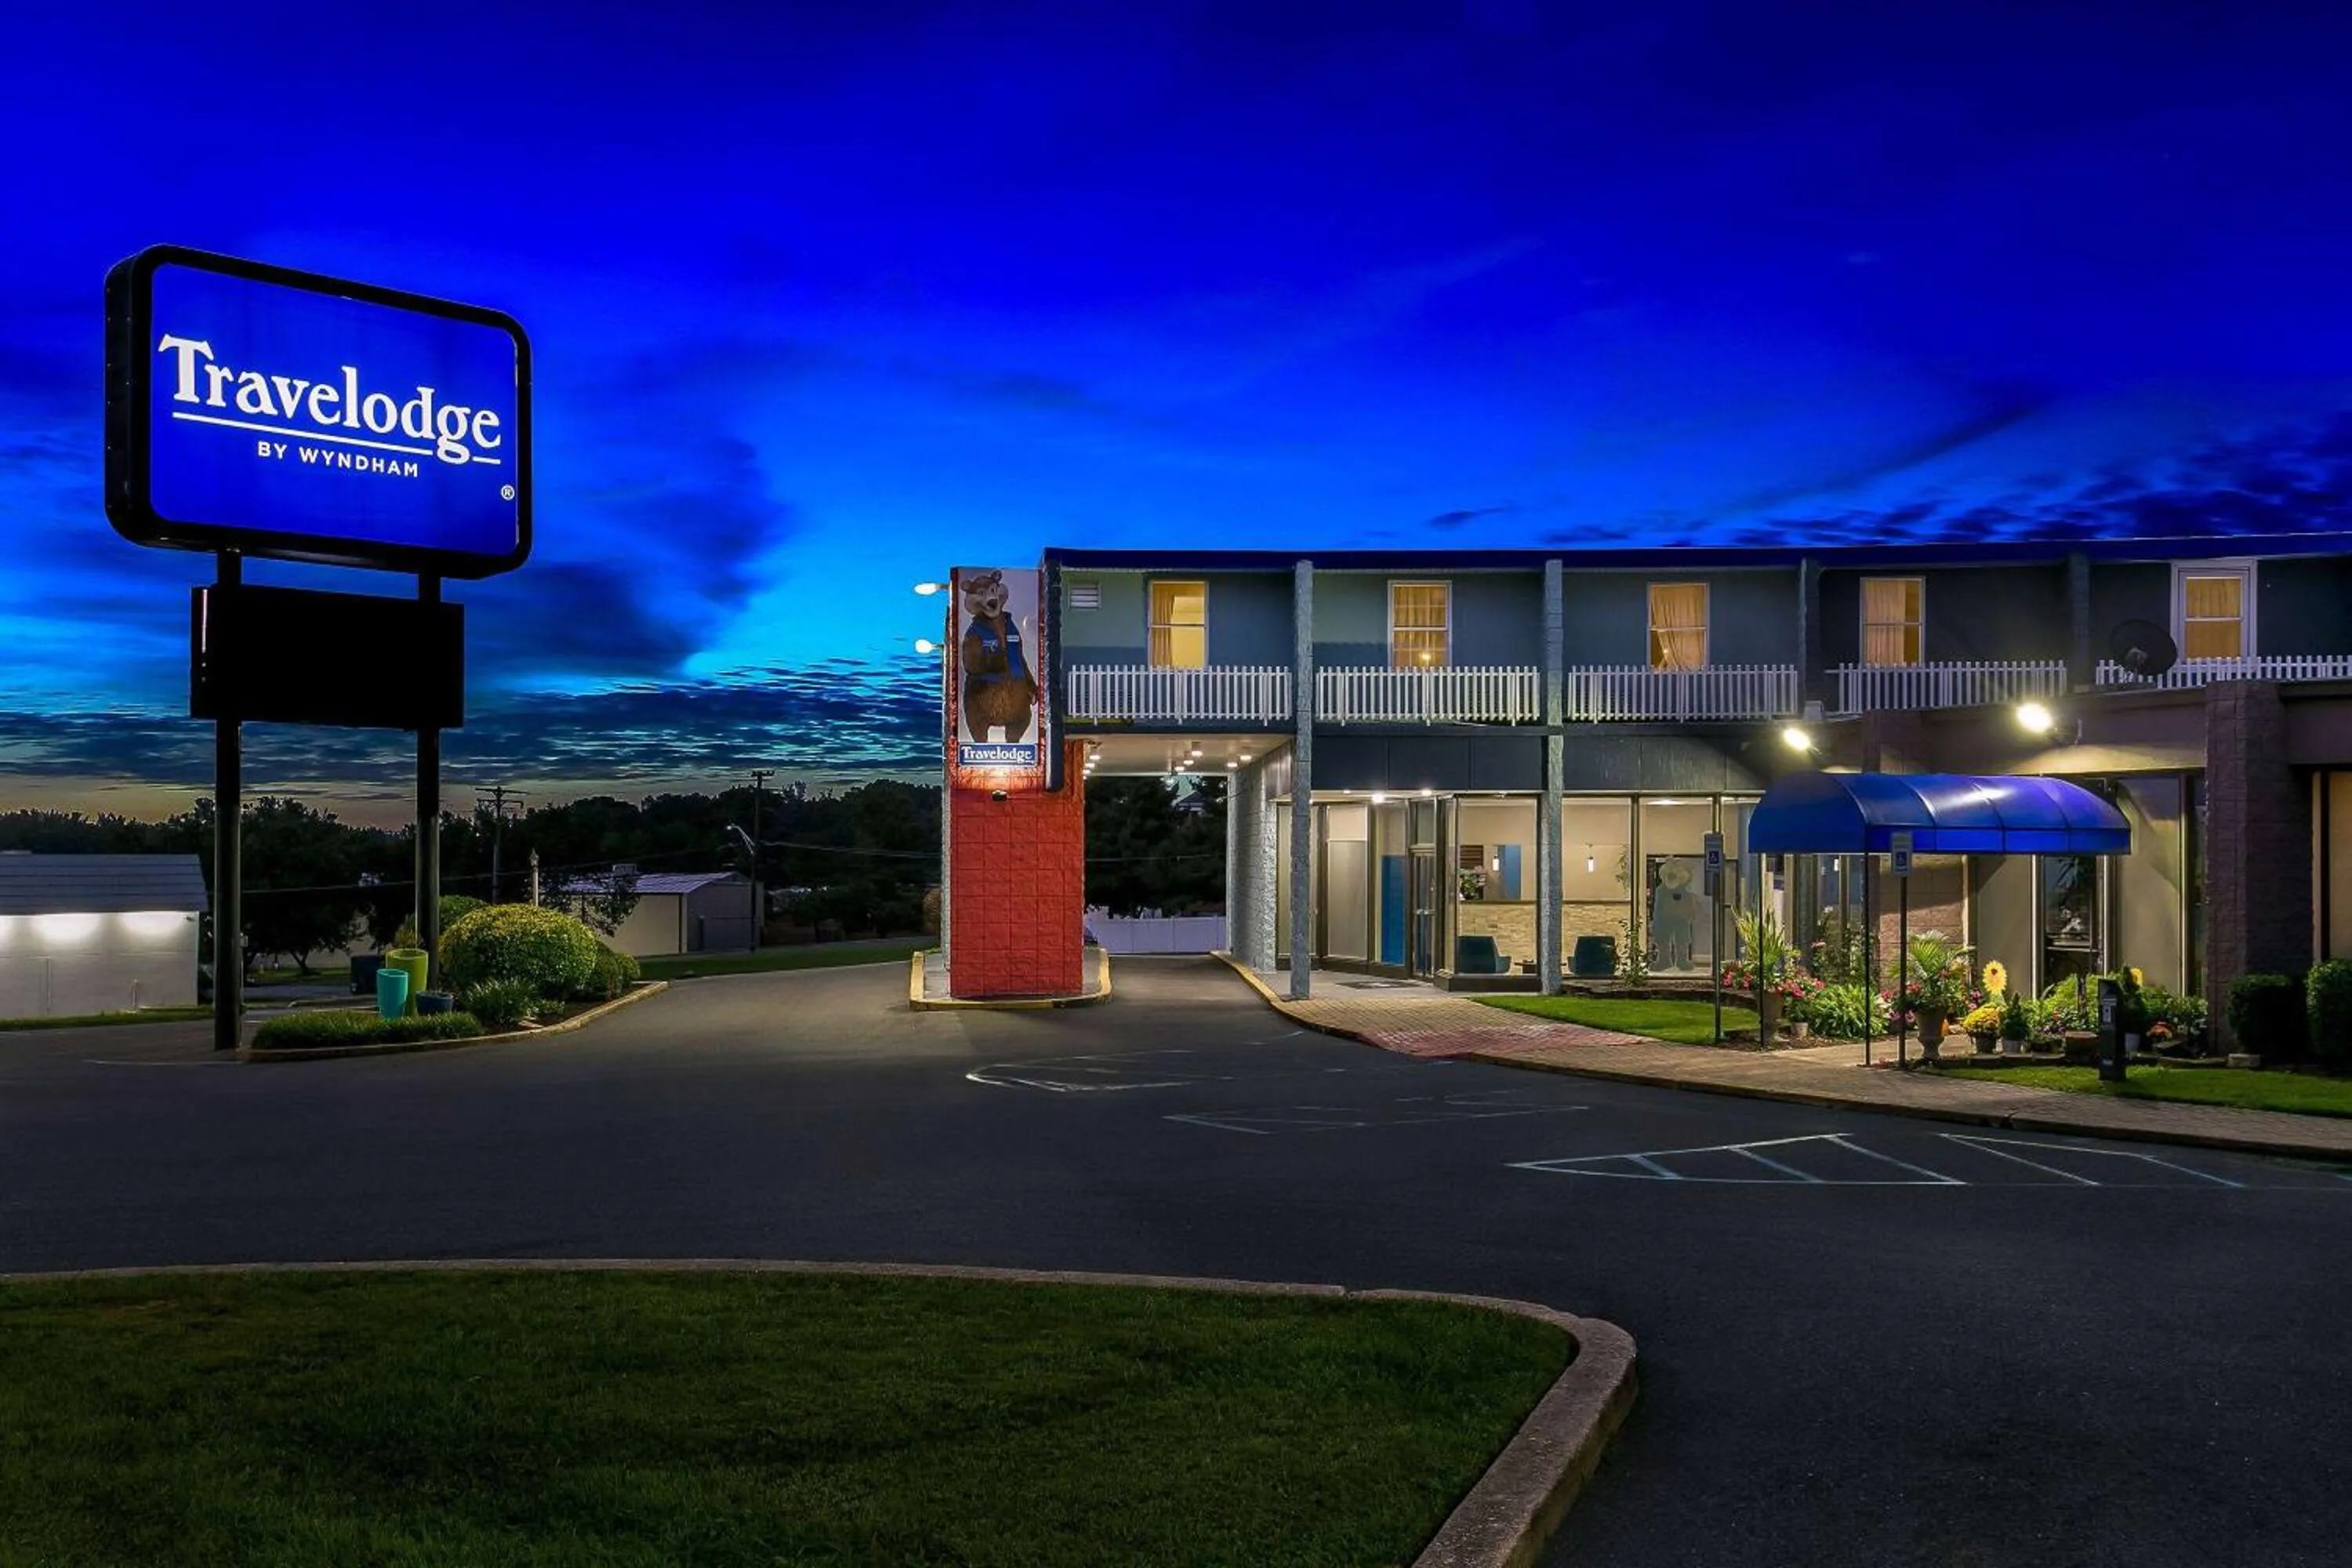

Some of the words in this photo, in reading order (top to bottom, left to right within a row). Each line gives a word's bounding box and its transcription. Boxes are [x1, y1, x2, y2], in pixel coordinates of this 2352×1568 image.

[158, 333, 501, 465] Travelodge
[257, 441, 288, 459] BY
[298, 446, 419, 478] WYNDHAM
[960, 746, 1033, 764] Travelodge
